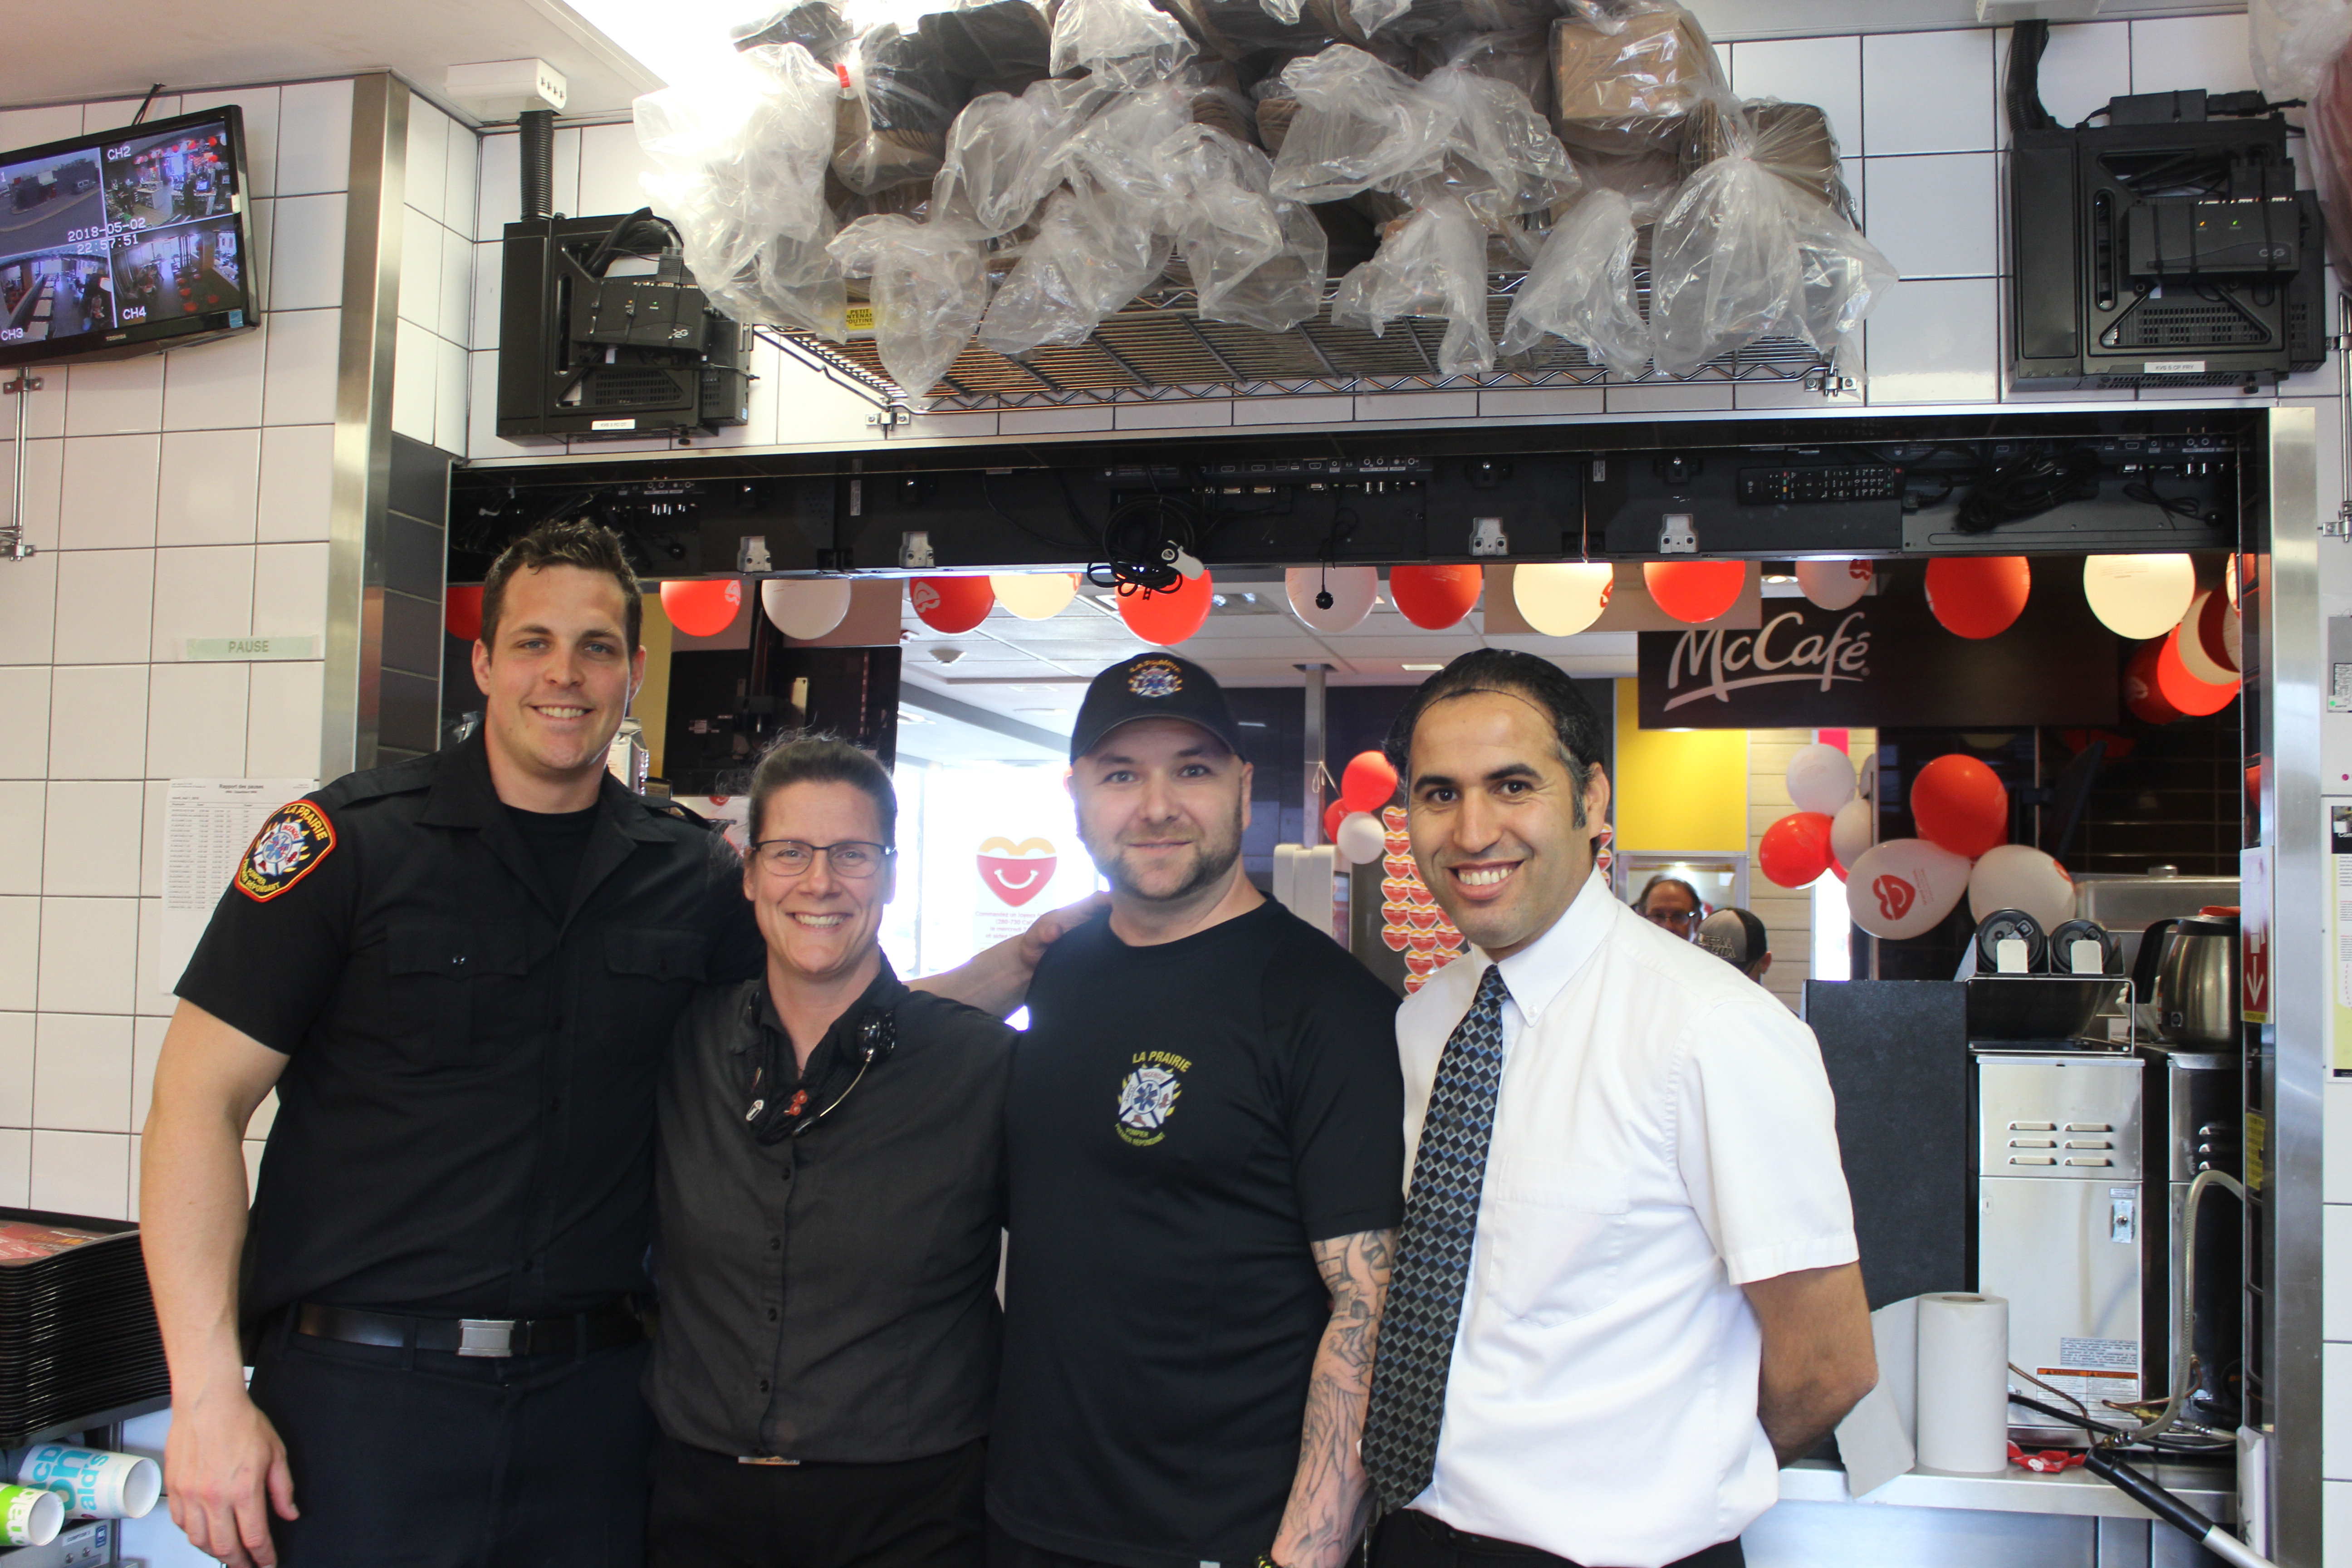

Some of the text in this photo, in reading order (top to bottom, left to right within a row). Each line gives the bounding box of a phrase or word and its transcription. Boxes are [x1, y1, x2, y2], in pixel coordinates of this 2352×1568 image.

[107, 146, 131, 160] CH2
[68, 217, 146, 242] 2018-05-02
[77, 233, 138, 255] 22:57:51
[2259, 248, 2285, 259] CG
[122, 306, 147, 320] CH4
[0, 327, 24, 341] CH3
[228, 640, 269, 652] PAUSE
[1668, 612, 1871, 702] McCafé
[283, 805, 328, 841] LA PRAIRIE
[1132, 1051, 1192, 1073] LA PRAIRIE
[27, 1446, 63, 1489] cD
